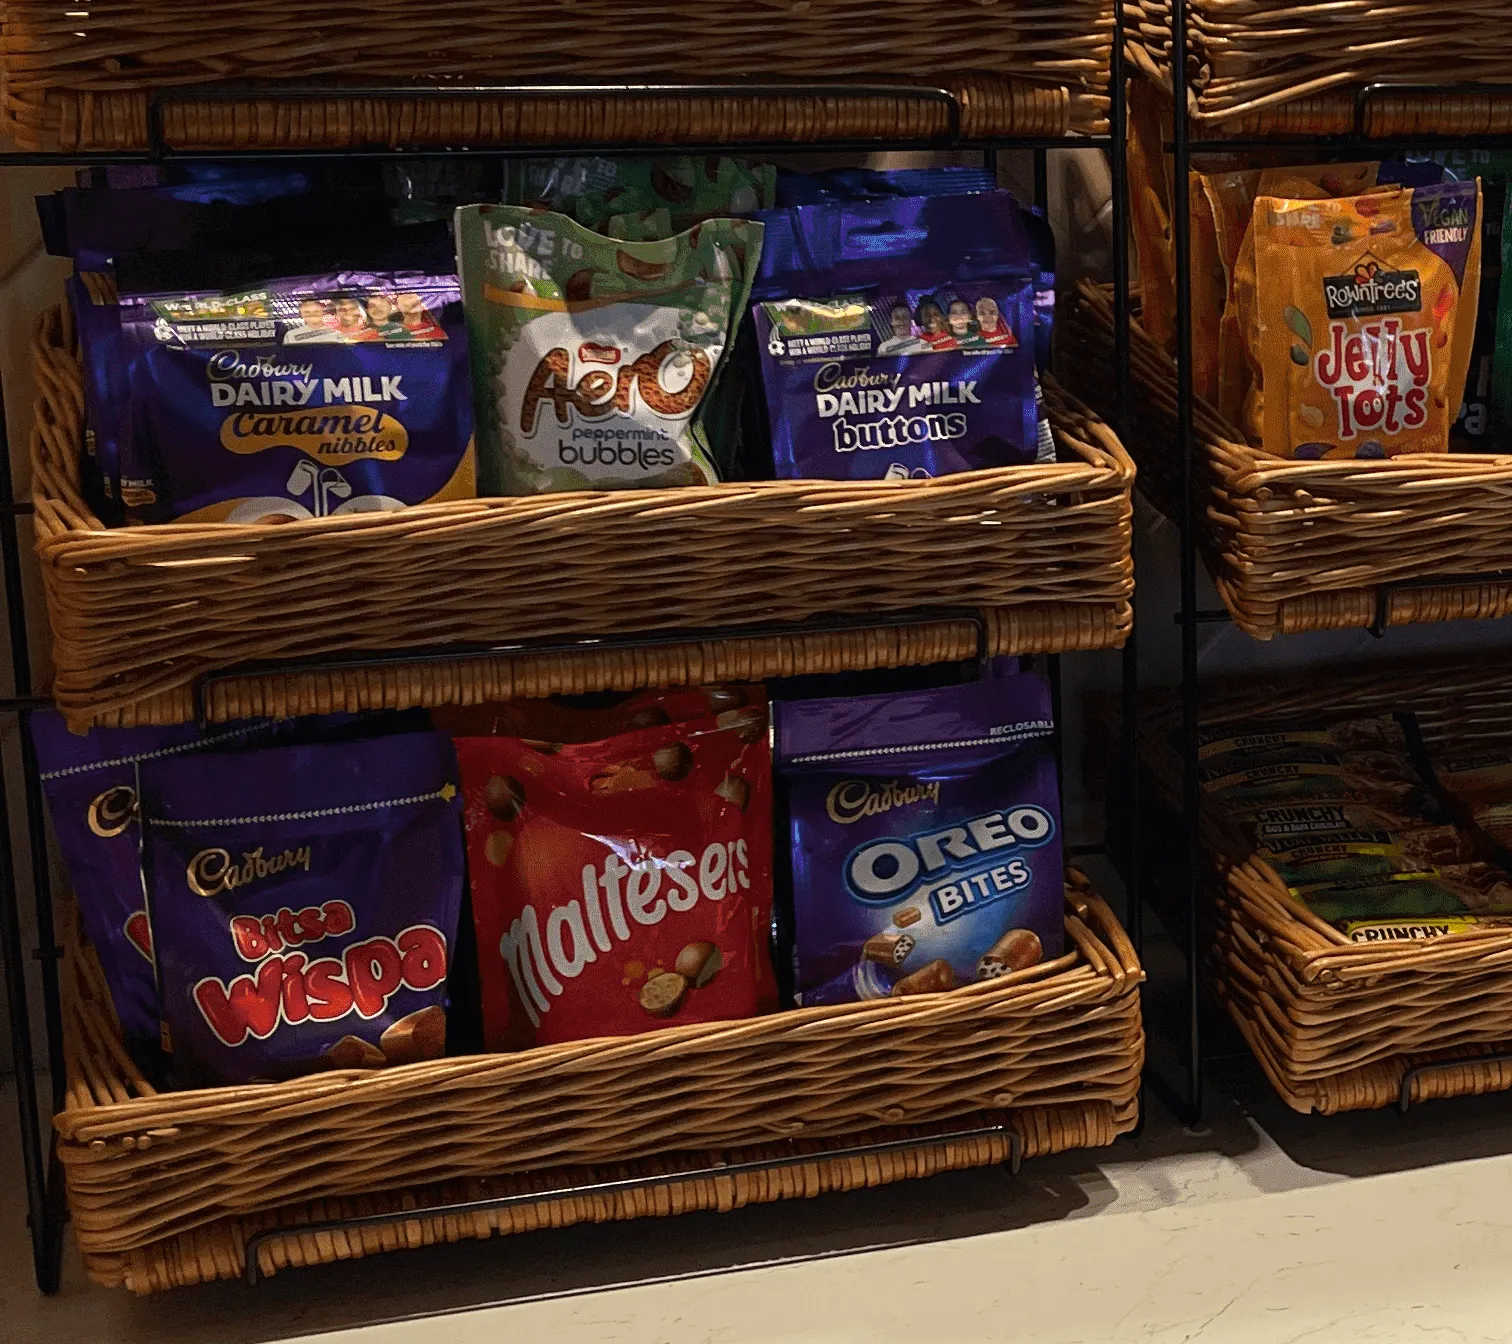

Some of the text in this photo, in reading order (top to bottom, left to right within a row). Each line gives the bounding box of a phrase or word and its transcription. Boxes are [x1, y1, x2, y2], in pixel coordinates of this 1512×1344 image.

[1420, 204, 1470, 228] VEGAN
[1424, 225, 1470, 245] FRIENDLY
[484, 221, 555, 256] LOVE
[206, 349, 312, 383] Cadbury
[1315, 317, 1432, 388] Jelly
[210, 375, 408, 408] DAIRY MILK
[520, 339, 712, 436] Aero
[813, 362, 901, 394] Cadbury
[816, 380, 981, 418] DAIRY MILK
[1329, 385, 1429, 440] Tots
[231, 407, 385, 438] Caramel
[572, 425, 669, 442] peppermint
[833, 412, 967, 452] buttons
[317, 436, 397, 455] nibbles
[558, 438, 675, 470] bubbles
[826, 779, 942, 825] Cadbury
[1254, 806, 1344, 824] CRUNCHY
[850, 807, 1050, 895] OREO
[186, 845, 311, 898] Cadbury
[935, 860, 1029, 916] BITES
[230, 899, 356, 962] Bitsa
[500, 838, 751, 1029] Maltesers
[193, 924, 448, 1048] Wispa
